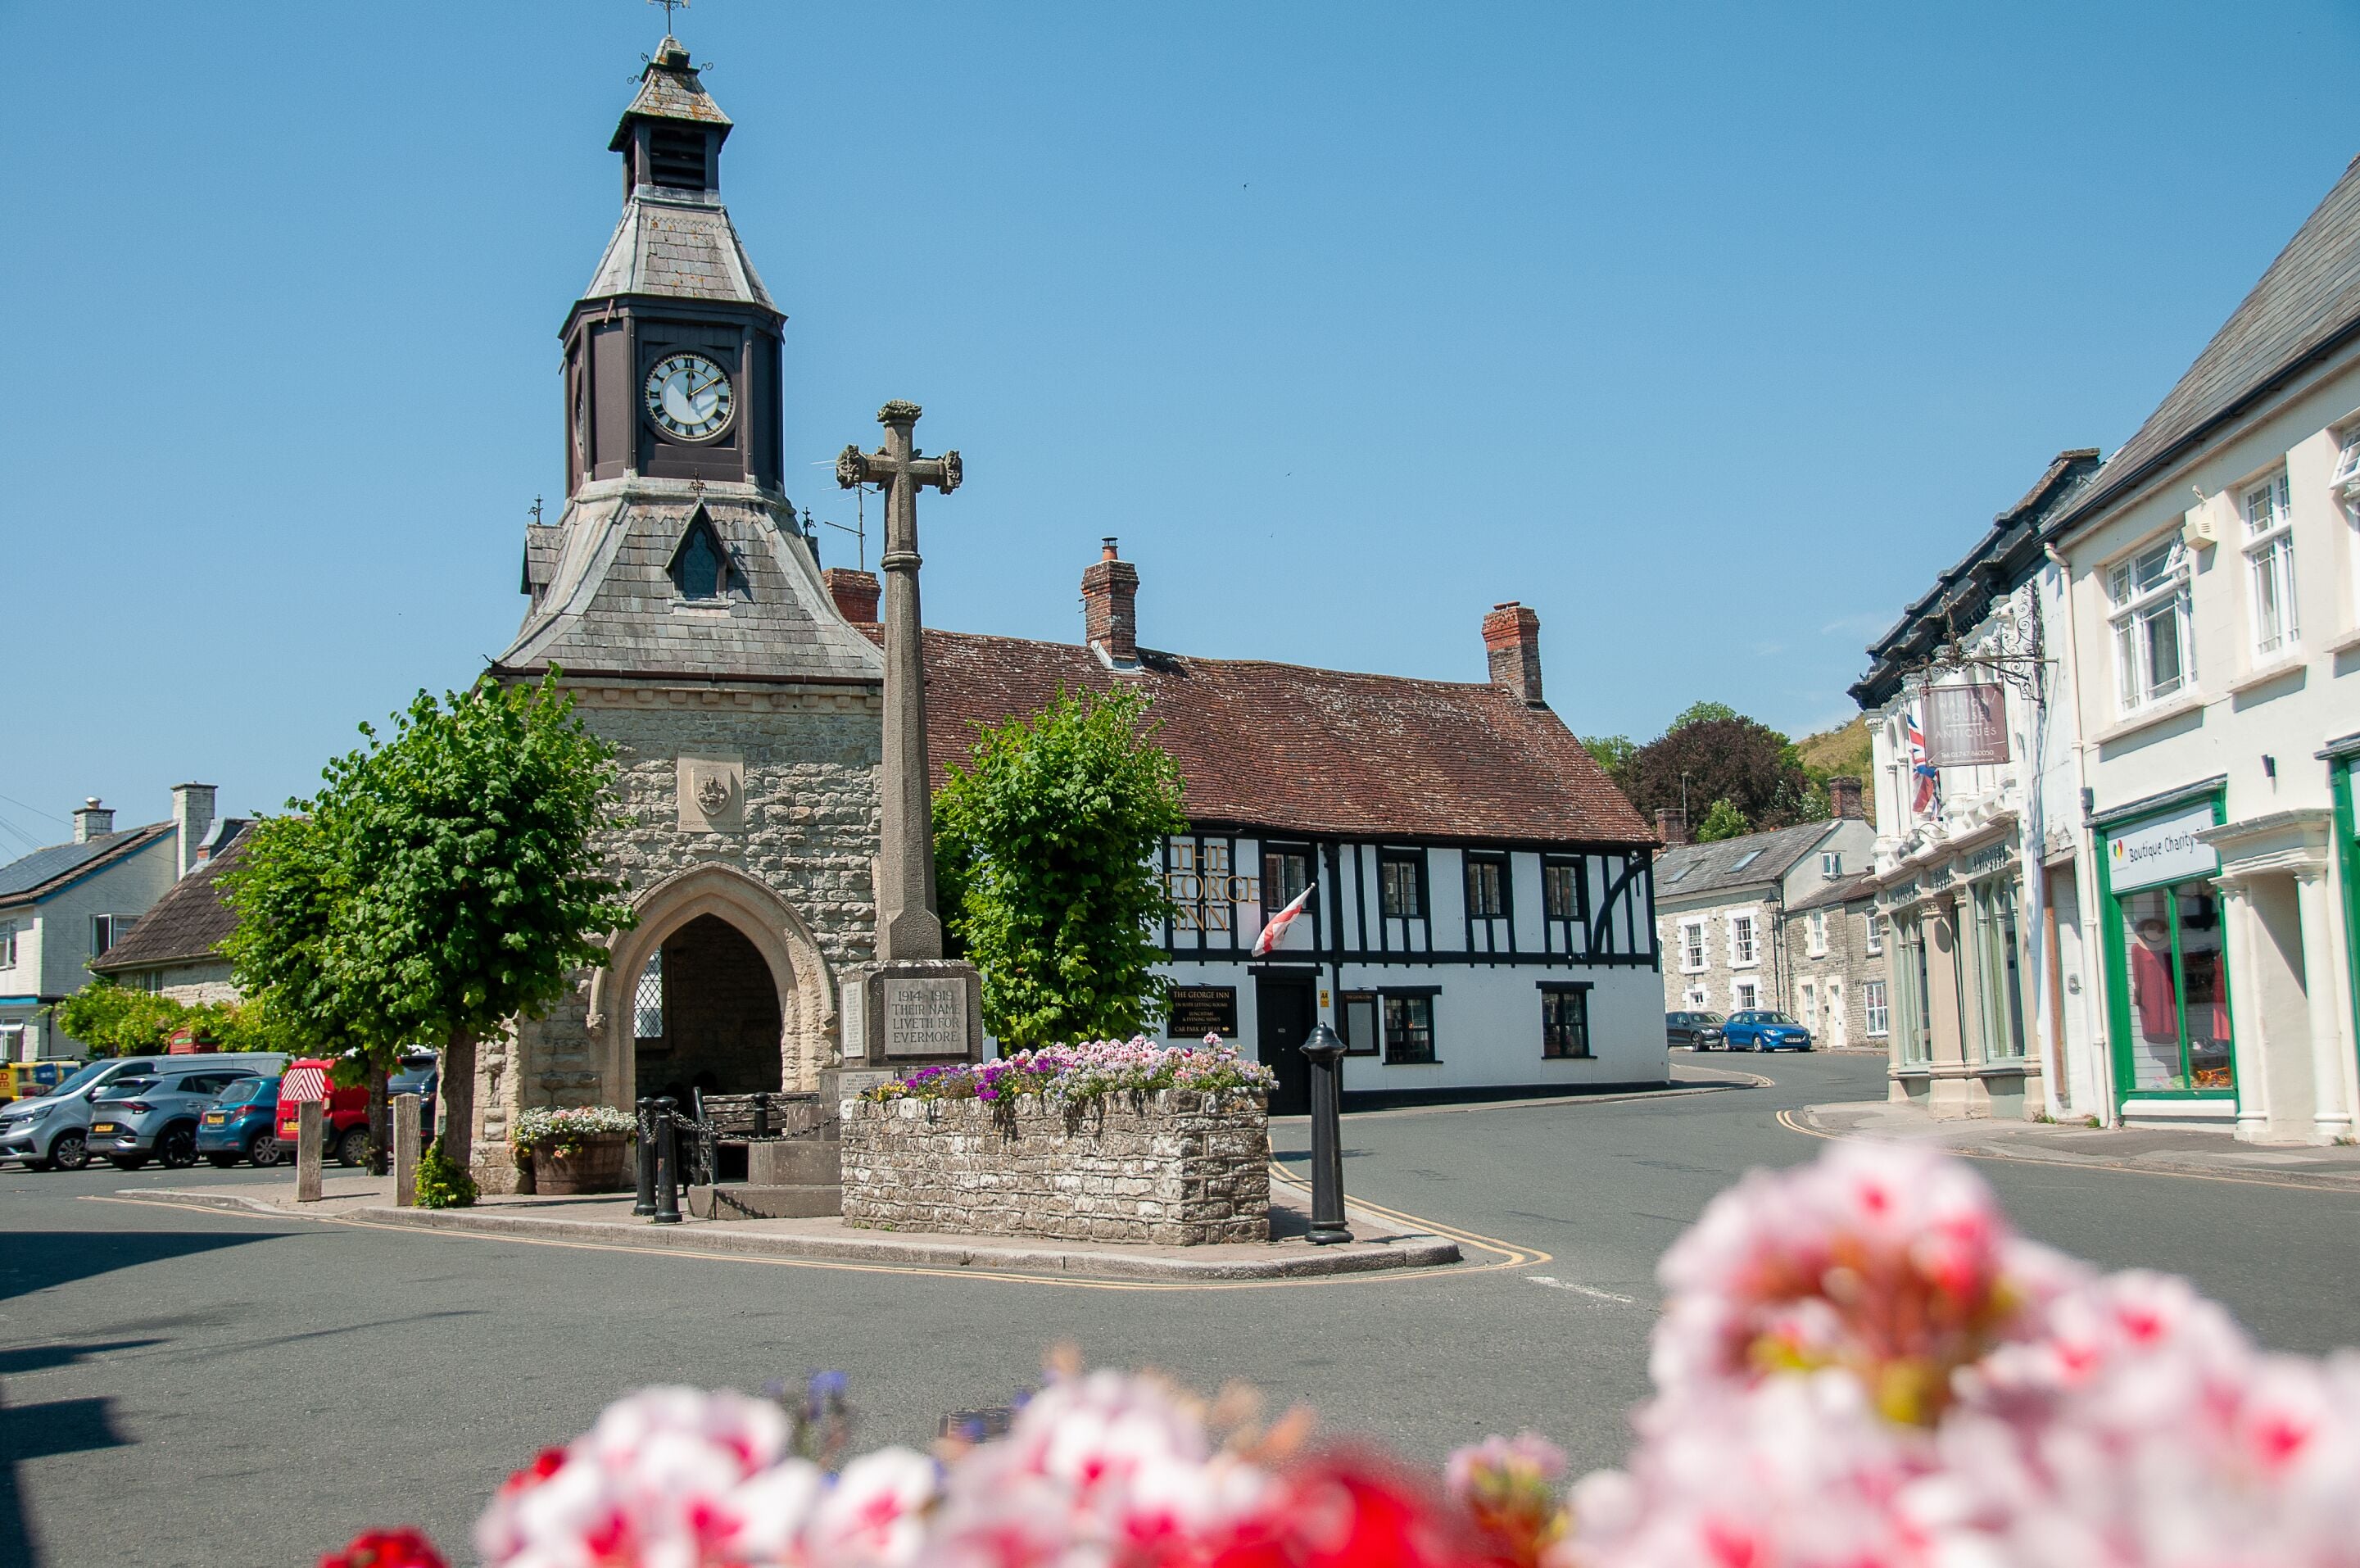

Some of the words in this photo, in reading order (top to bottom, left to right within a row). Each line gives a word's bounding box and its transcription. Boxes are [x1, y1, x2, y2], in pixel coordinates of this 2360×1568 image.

[1939, 697, 1989, 709] WALTON
[1943, 711, 1985, 722] HOUSE
[1936, 727, 1997, 739] ANTIQUES
[2129, 840, 2163, 863] Boutique
[2164, 830, 2194, 854] Charity
[1171, 843, 1229, 872] THE
[1153, 873, 1260, 904] EORGE
[891, 1004, 924, 1016] THEIR
[930, 1004, 960, 1015] NAME
[893, 1017, 933, 1030] LIVETH
[938, 1017, 960, 1029] FOR
